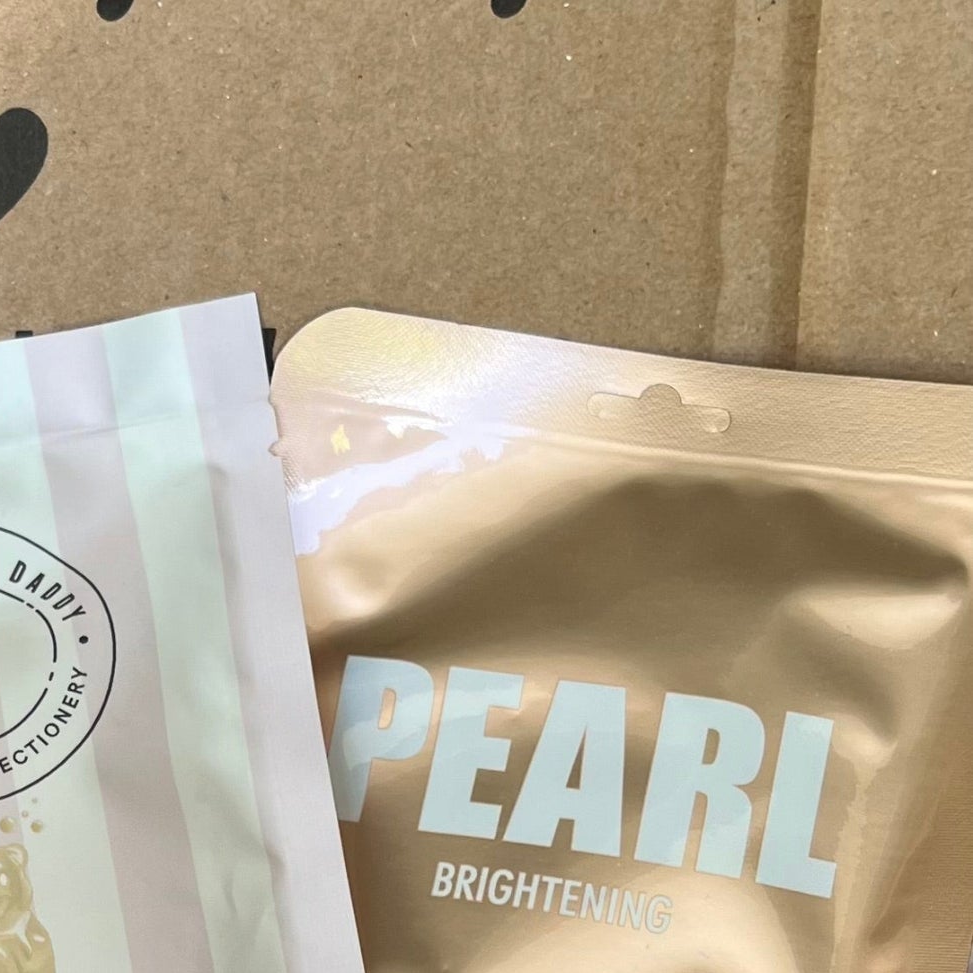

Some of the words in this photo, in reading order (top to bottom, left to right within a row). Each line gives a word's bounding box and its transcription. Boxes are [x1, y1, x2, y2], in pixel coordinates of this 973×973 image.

[9, 560, 86, 621] DADDY
[328, 655, 837, 899] PEARL
[431, 862, 674, 936] BRIGHTENING
